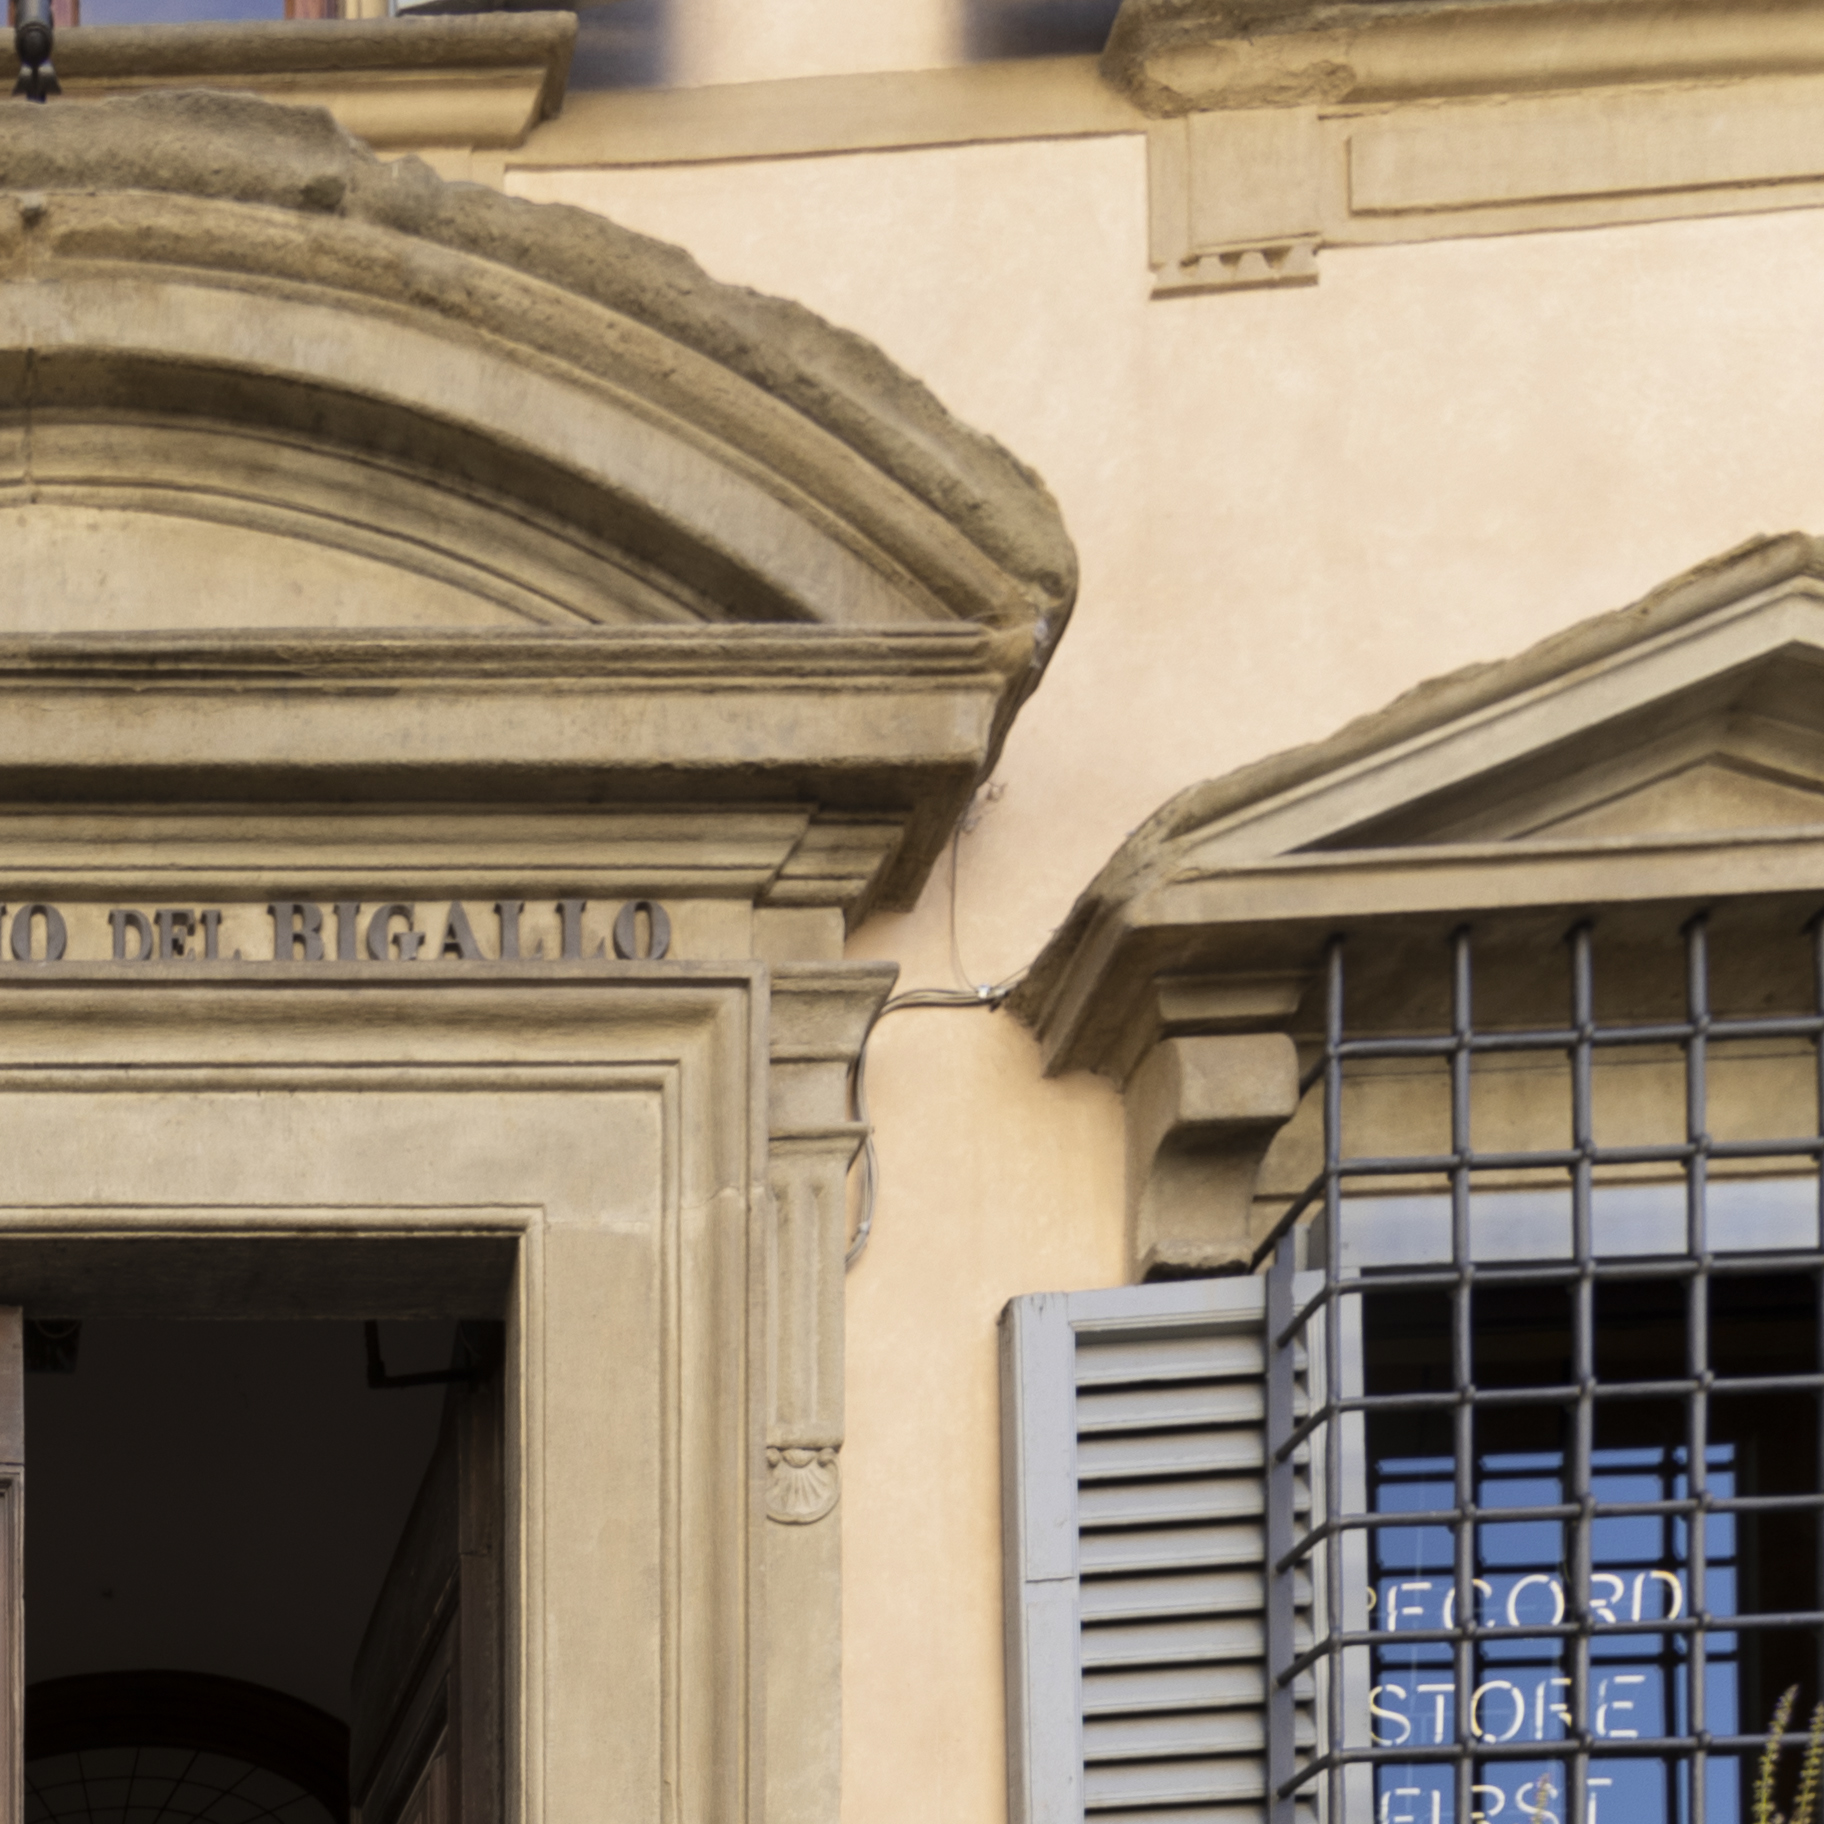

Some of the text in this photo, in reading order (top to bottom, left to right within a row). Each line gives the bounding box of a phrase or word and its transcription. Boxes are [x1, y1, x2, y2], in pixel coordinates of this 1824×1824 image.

[108, 908, 243, 961] DEL
[268, 899, 672, 961] BIGALLO
[1366, 1569, 1683, 1632] ECORD
[1369, 1672, 1646, 1746] STORE
